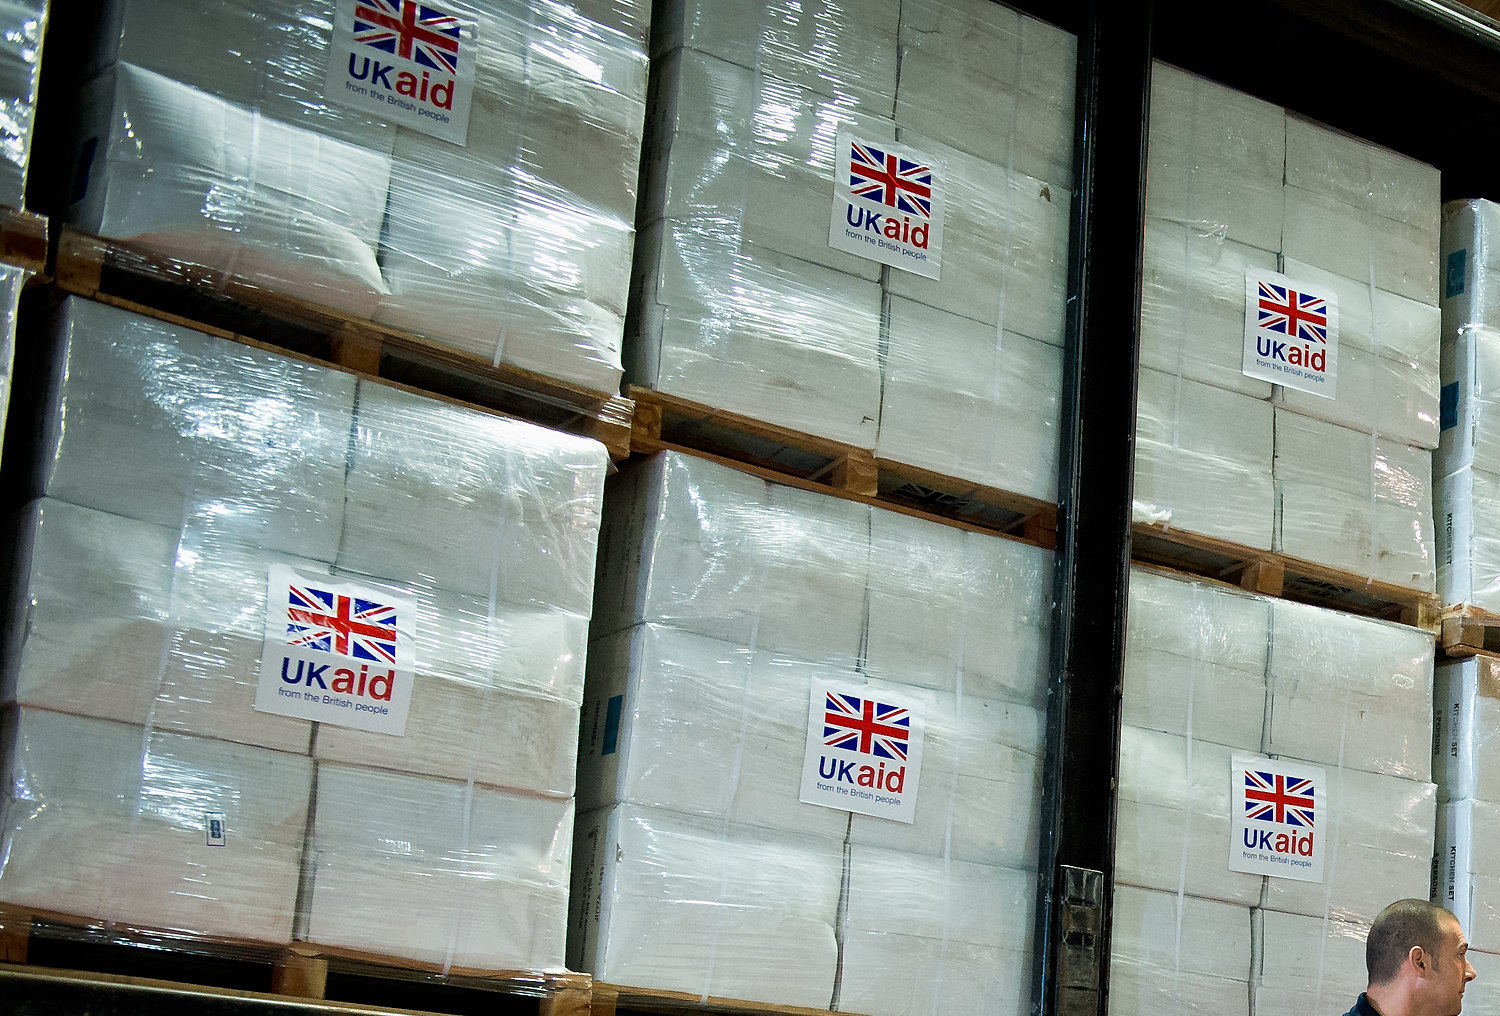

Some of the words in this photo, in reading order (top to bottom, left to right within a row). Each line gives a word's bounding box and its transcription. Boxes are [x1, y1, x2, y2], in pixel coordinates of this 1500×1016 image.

[348, 52, 454, 111] UKaid
[345, 81, 367, 95] from
[370, 90, 385, 101] the
[387, 95, 416, 111] British
[418, 107, 450, 123] people
[845, 228, 862, 240] from
[864, 235, 876, 245] the
[878, 239, 900, 252] British
[902, 248, 927, 260] people
[847, 203, 929, 250] UKaid
[1256, 358, 1271, 368] from
[1272, 362, 1283, 371] the
[1284, 365, 1303, 377] British
[1304, 372, 1325, 383] people
[1257, 335, 1326, 373] UKaid
[281, 657, 395, 702] UKaid
[278, 687, 302, 699] from
[304, 692, 320, 703] the
[322, 695, 352, 709] British
[354, 702, 389, 715] people
[816, 781, 835, 792] from
[836, 786, 849, 795] the
[850, 788, 874, 800] British
[875, 794, 901, 805] people
[819, 756, 906, 794] UKaid
[1242, 851, 1258, 860] from
[1270, 855, 1290, 865] British
[1290, 859, 1312, 868] people
[1243, 828, 1314, 857] UKaid
[1449, 845, 1457, 883] KITCHEN
